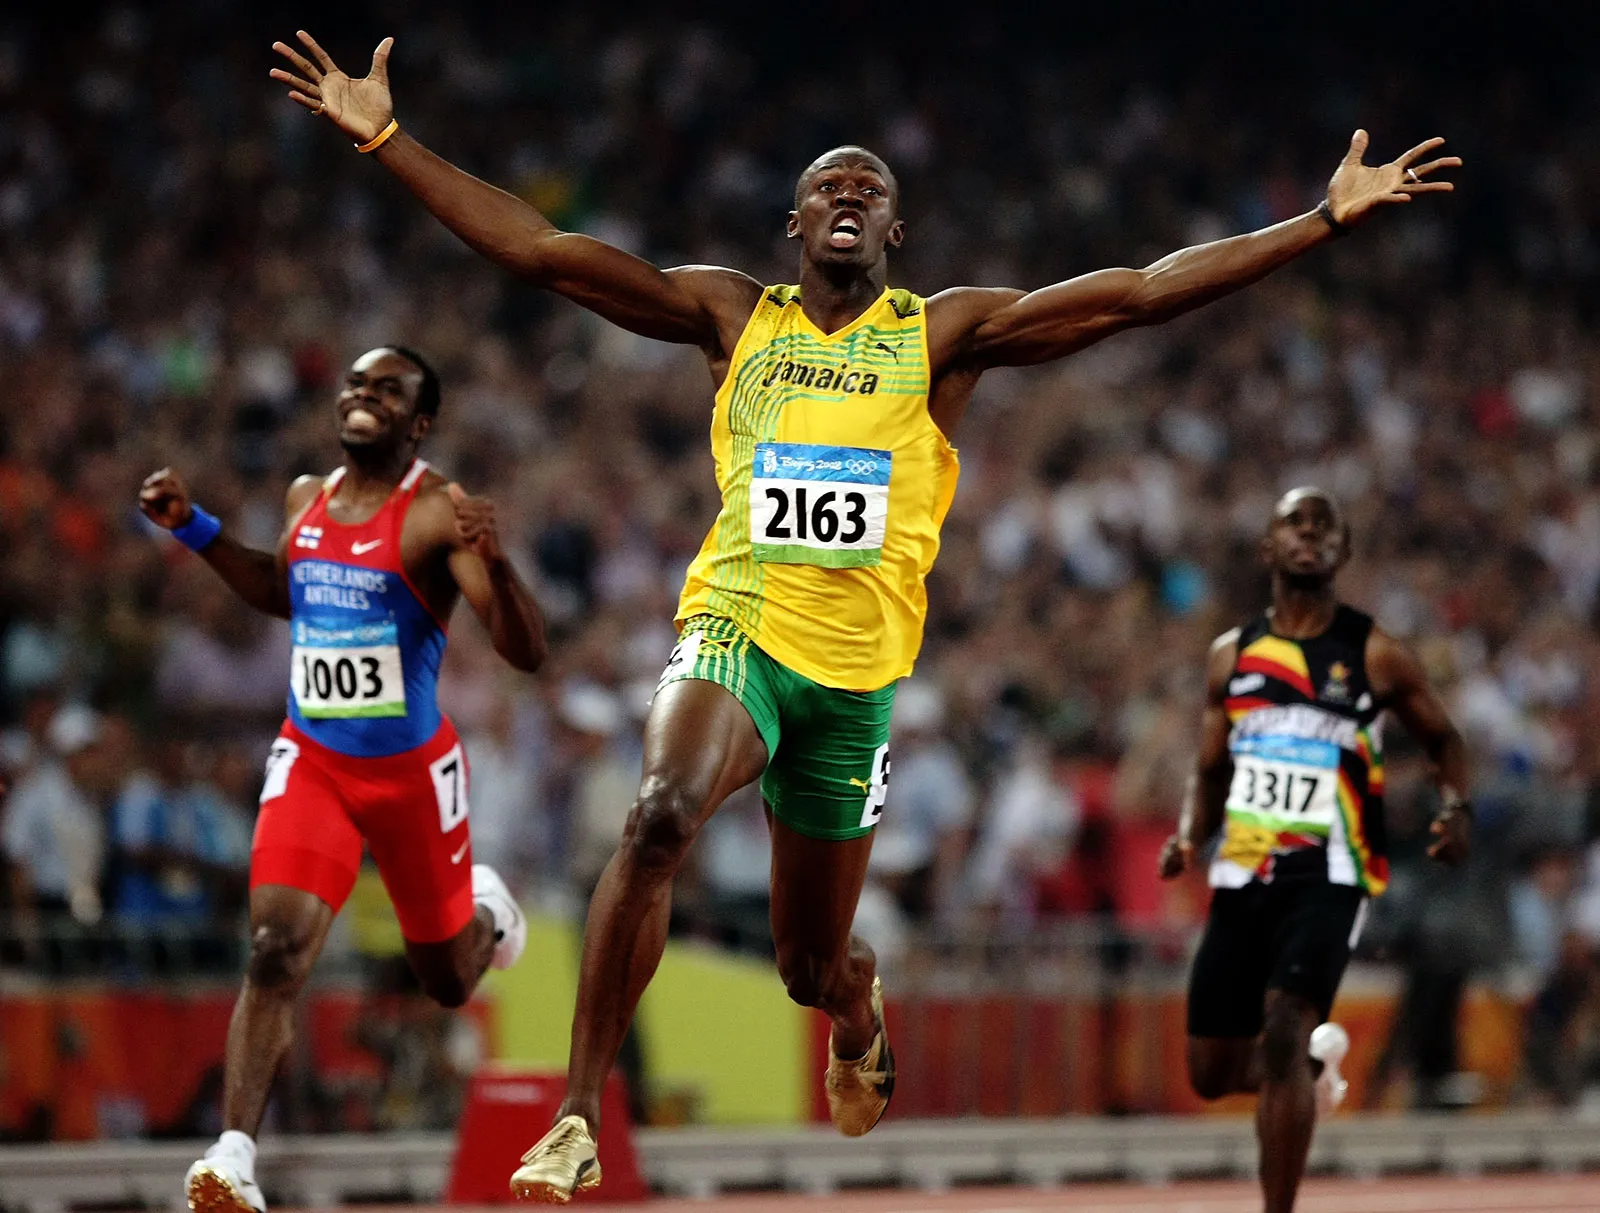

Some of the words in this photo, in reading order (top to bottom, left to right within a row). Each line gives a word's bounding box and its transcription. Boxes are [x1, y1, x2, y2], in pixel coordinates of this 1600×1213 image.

[762, 352, 879, 395] jamaica
[779, 456, 815, 472] Beijing
[764, 487, 867, 543] 2163
[304, 583, 371, 610] ANTILLES
[303, 655, 383, 699] 1003
[440, 759, 459, 816] 7
[1245, 768, 1318, 813] 3317
